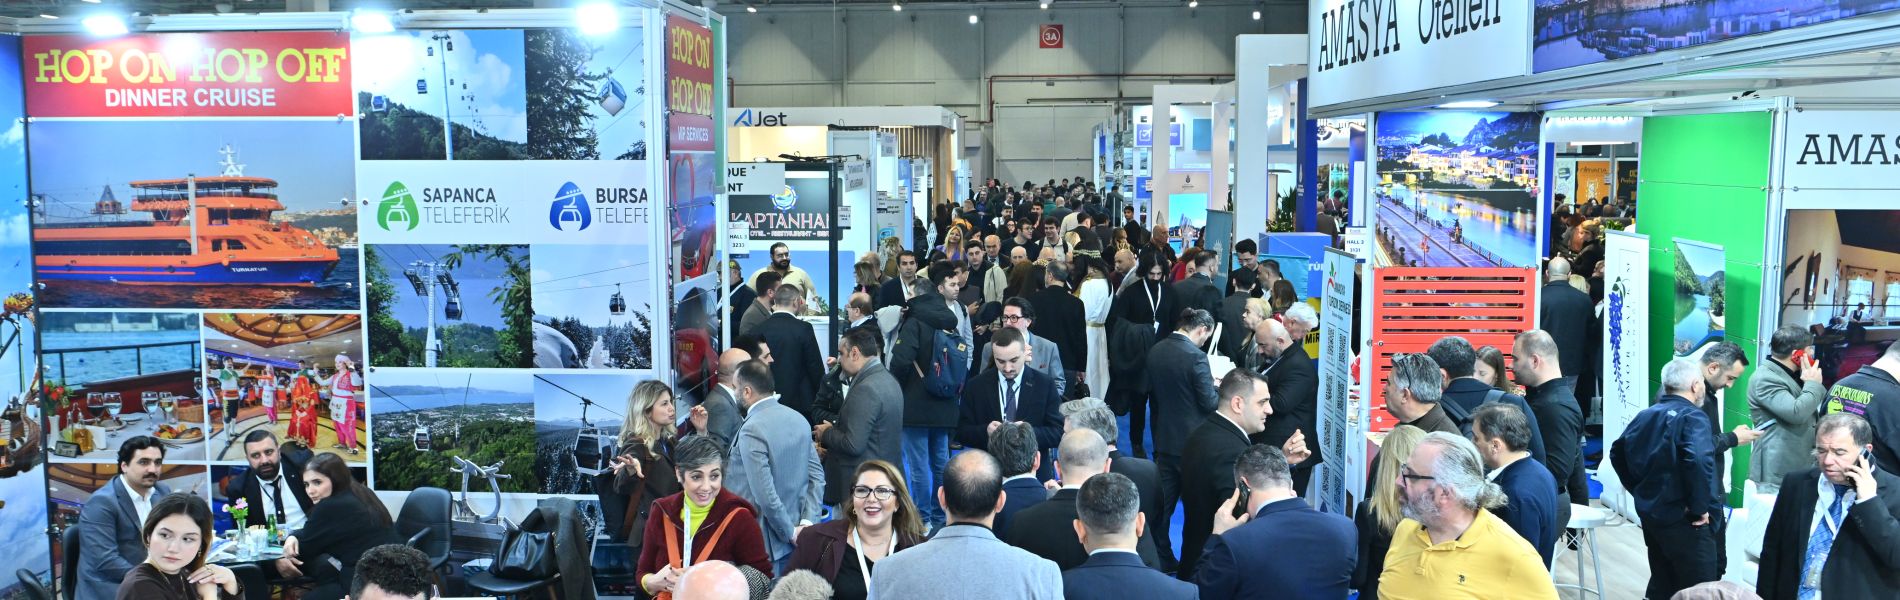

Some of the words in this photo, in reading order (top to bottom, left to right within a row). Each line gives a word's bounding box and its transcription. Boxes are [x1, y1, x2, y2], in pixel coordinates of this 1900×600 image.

[1045, 32, 1057, 41] 3A
[1318, 0, 1400, 72] AMASYA
[671, 26, 694, 65] HOP
[694, 33, 711, 70] ON
[35, 49, 113, 84] HOP
[119, 48, 177, 84] ON
[190, 48, 268, 83] HOP
[276, 47, 346, 83] OFF
[105, 88, 188, 107] DINNER
[193, 88, 276, 106] CRUISE
[671, 76, 694, 114] HOP
[694, 81, 713, 116] OFF
[677, 125, 686, 140] VIP
[686, 127, 709, 142] SERVICES
[1796, 133, 1900, 165] AMA
[423, 187, 497, 203] SAPANCA
[596, 187, 648, 203] BURSA
[423, 204, 510, 224] TELEFERİK
